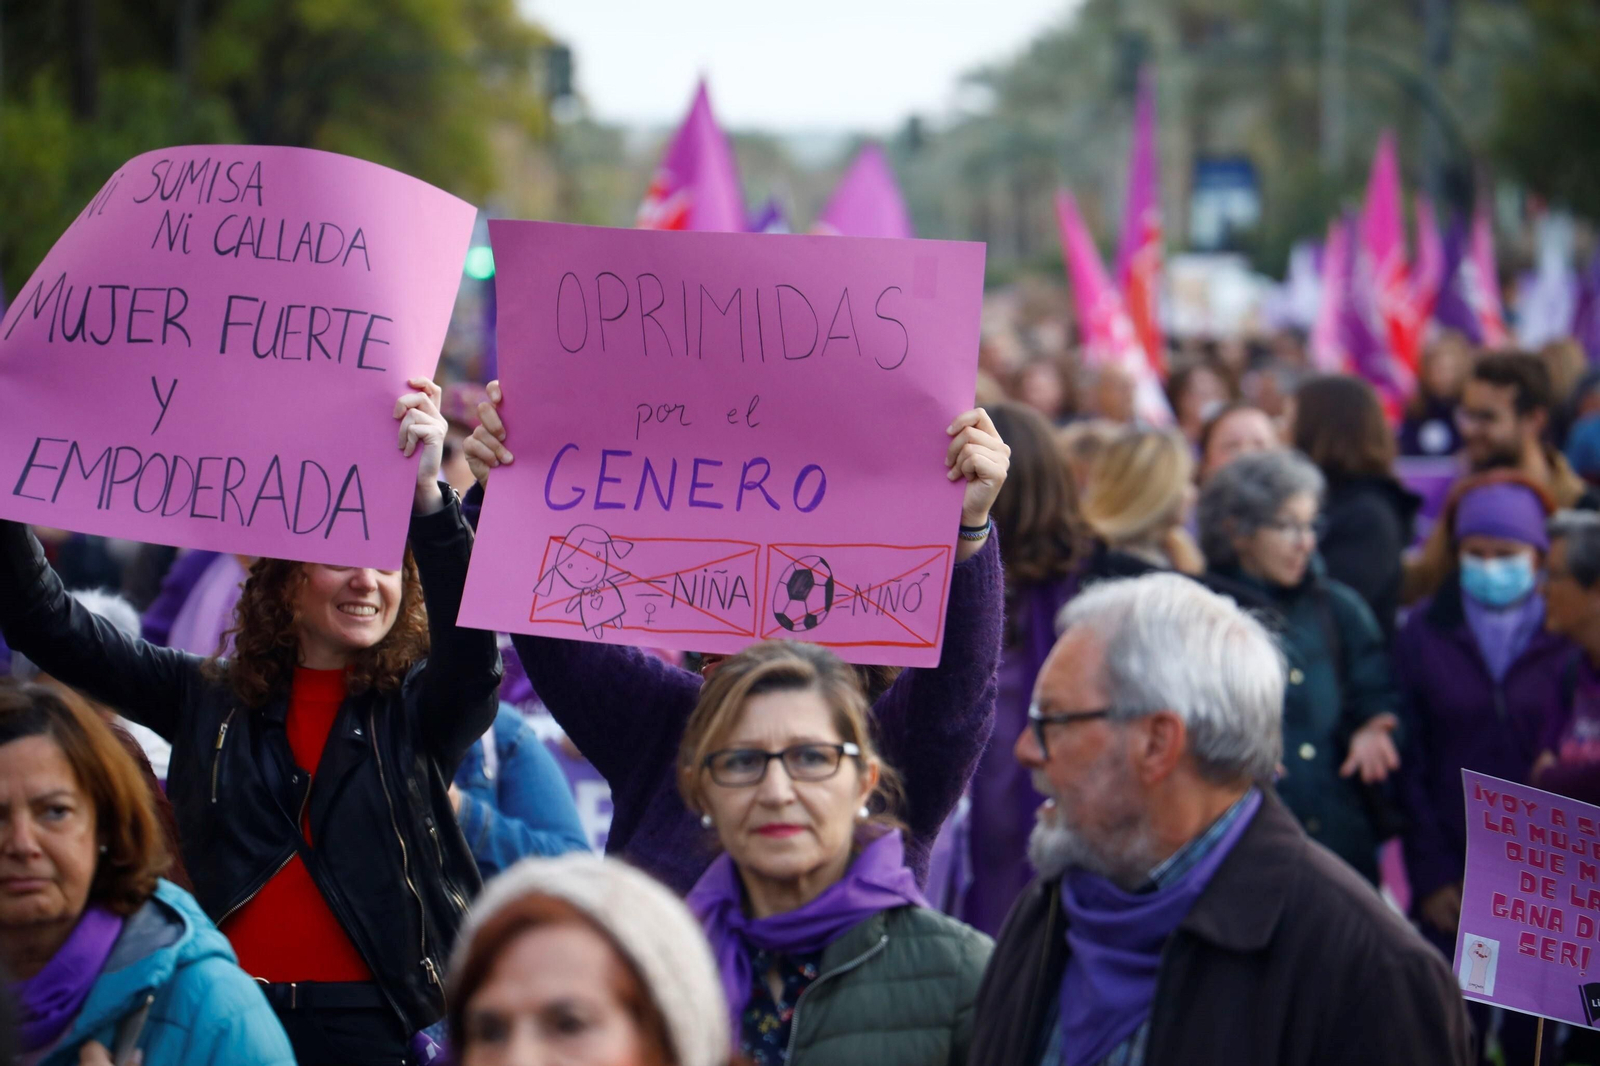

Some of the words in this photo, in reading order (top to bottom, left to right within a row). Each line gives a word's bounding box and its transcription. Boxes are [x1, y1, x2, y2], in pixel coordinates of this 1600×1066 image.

[133, 157, 263, 206] SUMISA
[213, 213, 371, 271] CALLADA
[4, 271, 191, 347] MUJER
[218, 295, 394, 371] FUERTE
[556, 272, 909, 371] OPRIMIDAS
[636, 402, 692, 440] por
[726, 394, 760, 428] el
[12, 437, 370, 541] EMPODERADA
[543, 443, 828, 513] GENERO
[1484, 810, 1517, 837] LA
[1551, 807, 1567, 828] A
[1577, 816, 1600, 837] S
[1505, 841, 1566, 876] QUE
[1519, 870, 1557, 900] DE
[1569, 883, 1600, 912] LA
[1491, 891, 1564, 934] GANA
[1575, 914, 1600, 943] D
[1518, 931, 1591, 977] SER!
